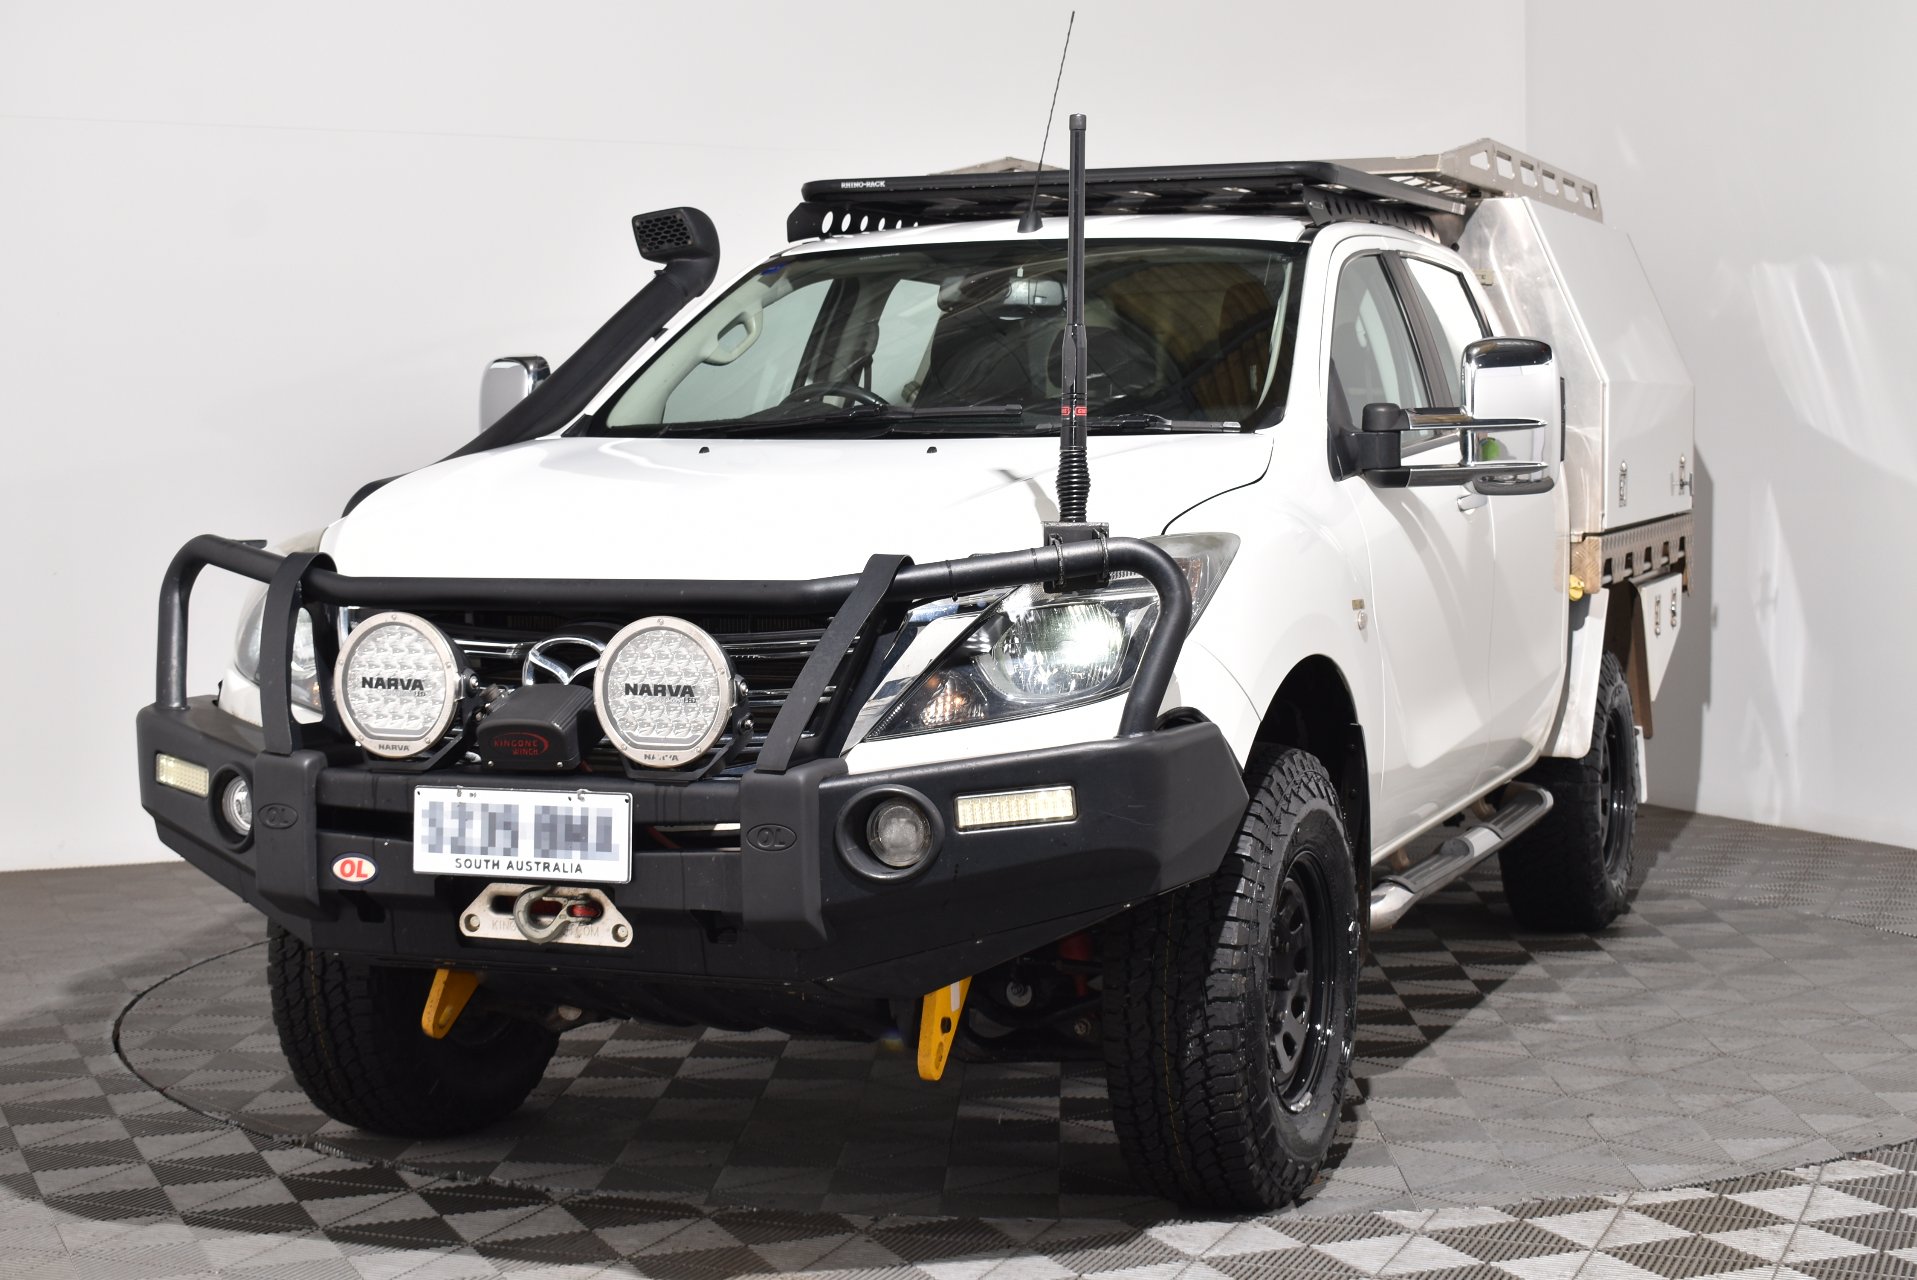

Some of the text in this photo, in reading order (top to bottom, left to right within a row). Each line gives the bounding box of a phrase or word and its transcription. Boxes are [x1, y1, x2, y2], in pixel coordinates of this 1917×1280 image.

[840, 180, 886, 189] RHINO-RACK
[361, 676, 424, 691] NARVA
[624, 683, 695, 697] NARVA
[378, 743, 410, 751] NARVA
[757, 827, 786, 848] OL
[339, 859, 369, 878] OL
[455, 858, 583, 874] SOUTH AUSTRALIA
